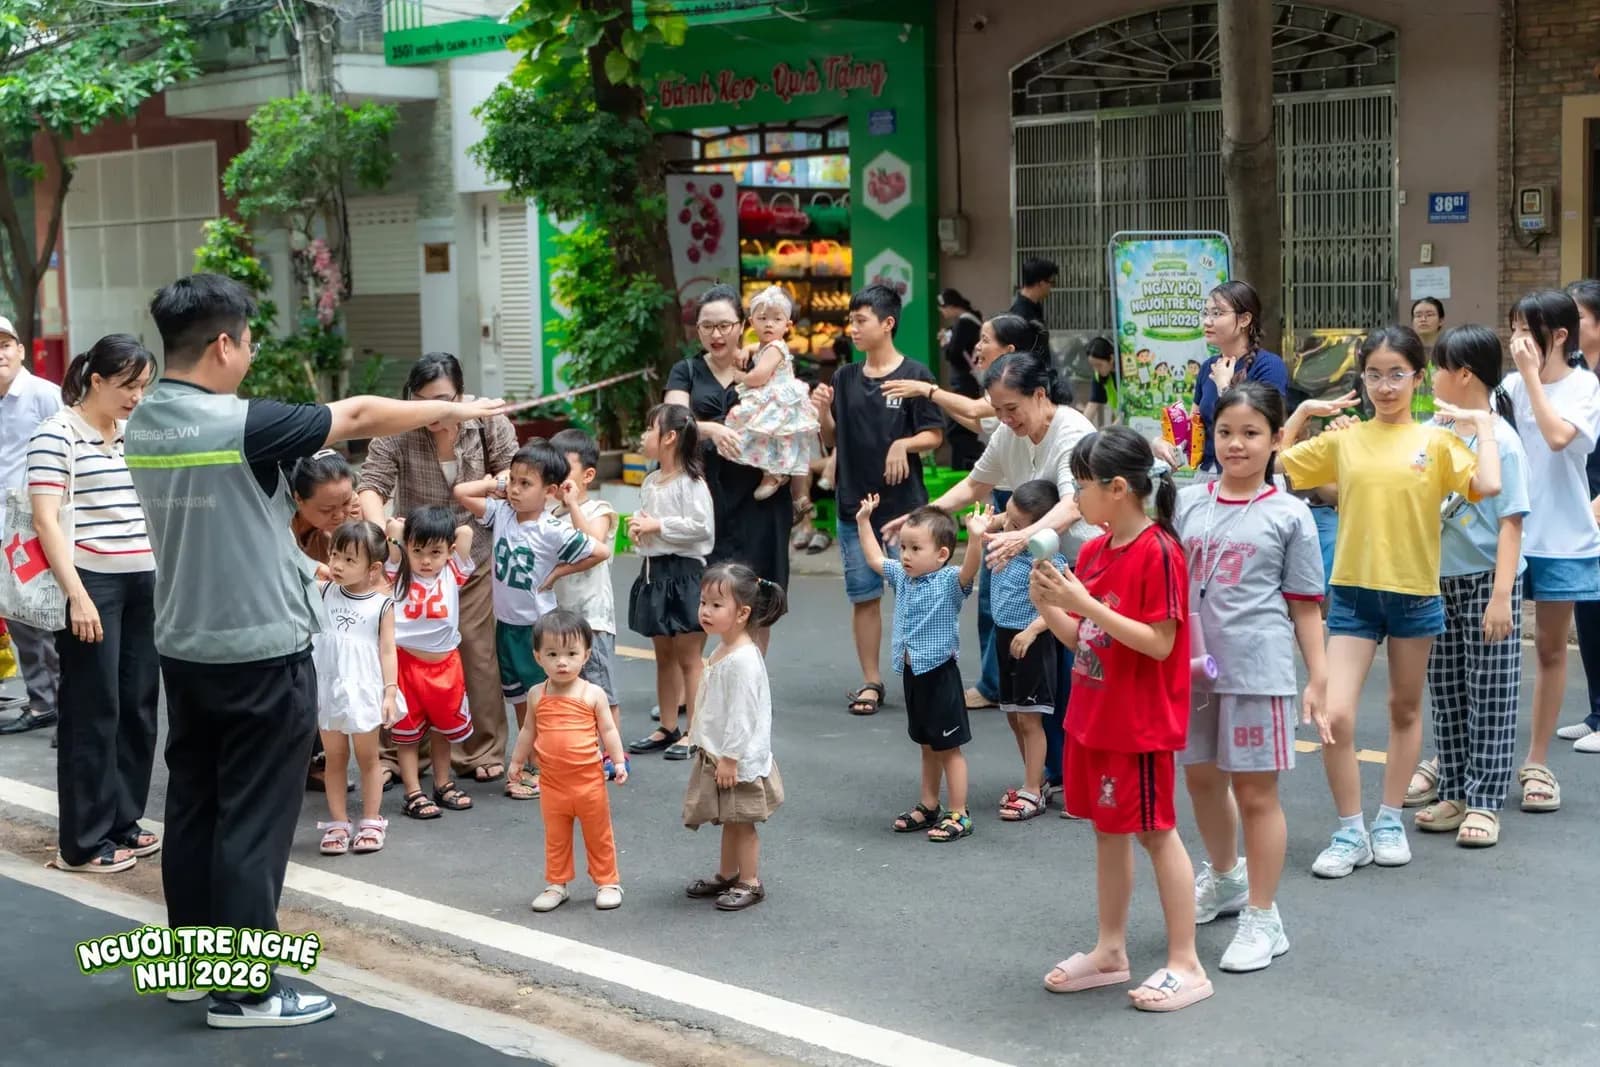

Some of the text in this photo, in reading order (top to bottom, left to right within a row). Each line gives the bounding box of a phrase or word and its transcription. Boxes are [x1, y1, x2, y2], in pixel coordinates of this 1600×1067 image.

[659, 74, 715, 109] Bánh
[717, 70, 758, 109] Kẹo
[773, 59, 821, 104] Quà
[825, 54, 886, 98] Tặng
[1143, 278, 1201, 298] NGÀY HỘI
[1166, 298, 1186, 310] TRE
[1187, 298, 1206, 313] NG
[1170, 313, 1200, 328] 2026
[494, 537, 536, 591] 92
[403, 579, 448, 620] 92
